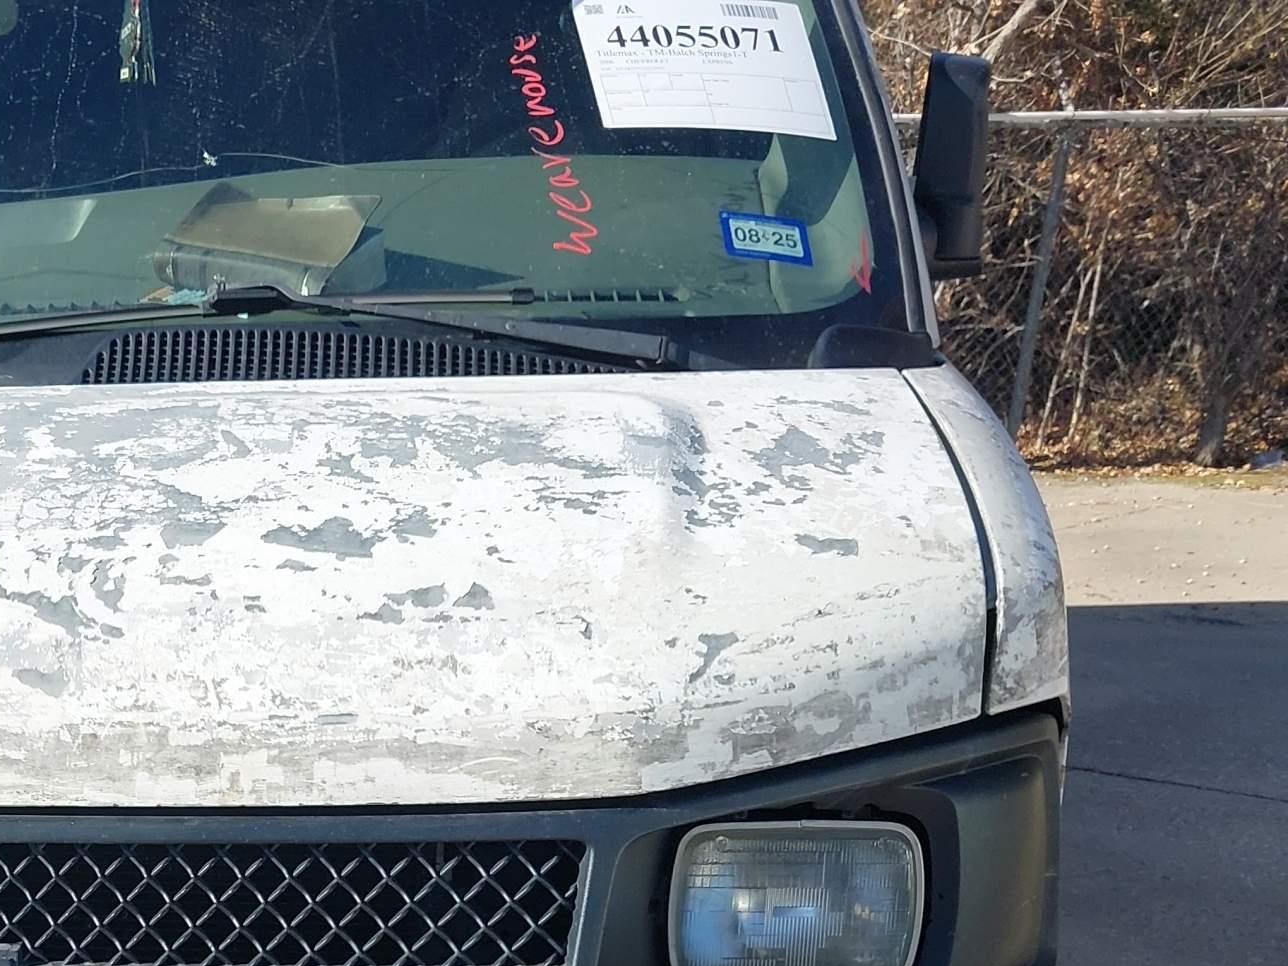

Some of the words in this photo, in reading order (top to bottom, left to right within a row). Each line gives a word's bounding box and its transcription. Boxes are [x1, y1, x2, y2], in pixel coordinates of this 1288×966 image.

[607, 24, 784, 53] 44055071
[734, 227, 761, 243] 08
[772, 231, 797, 249] 25
